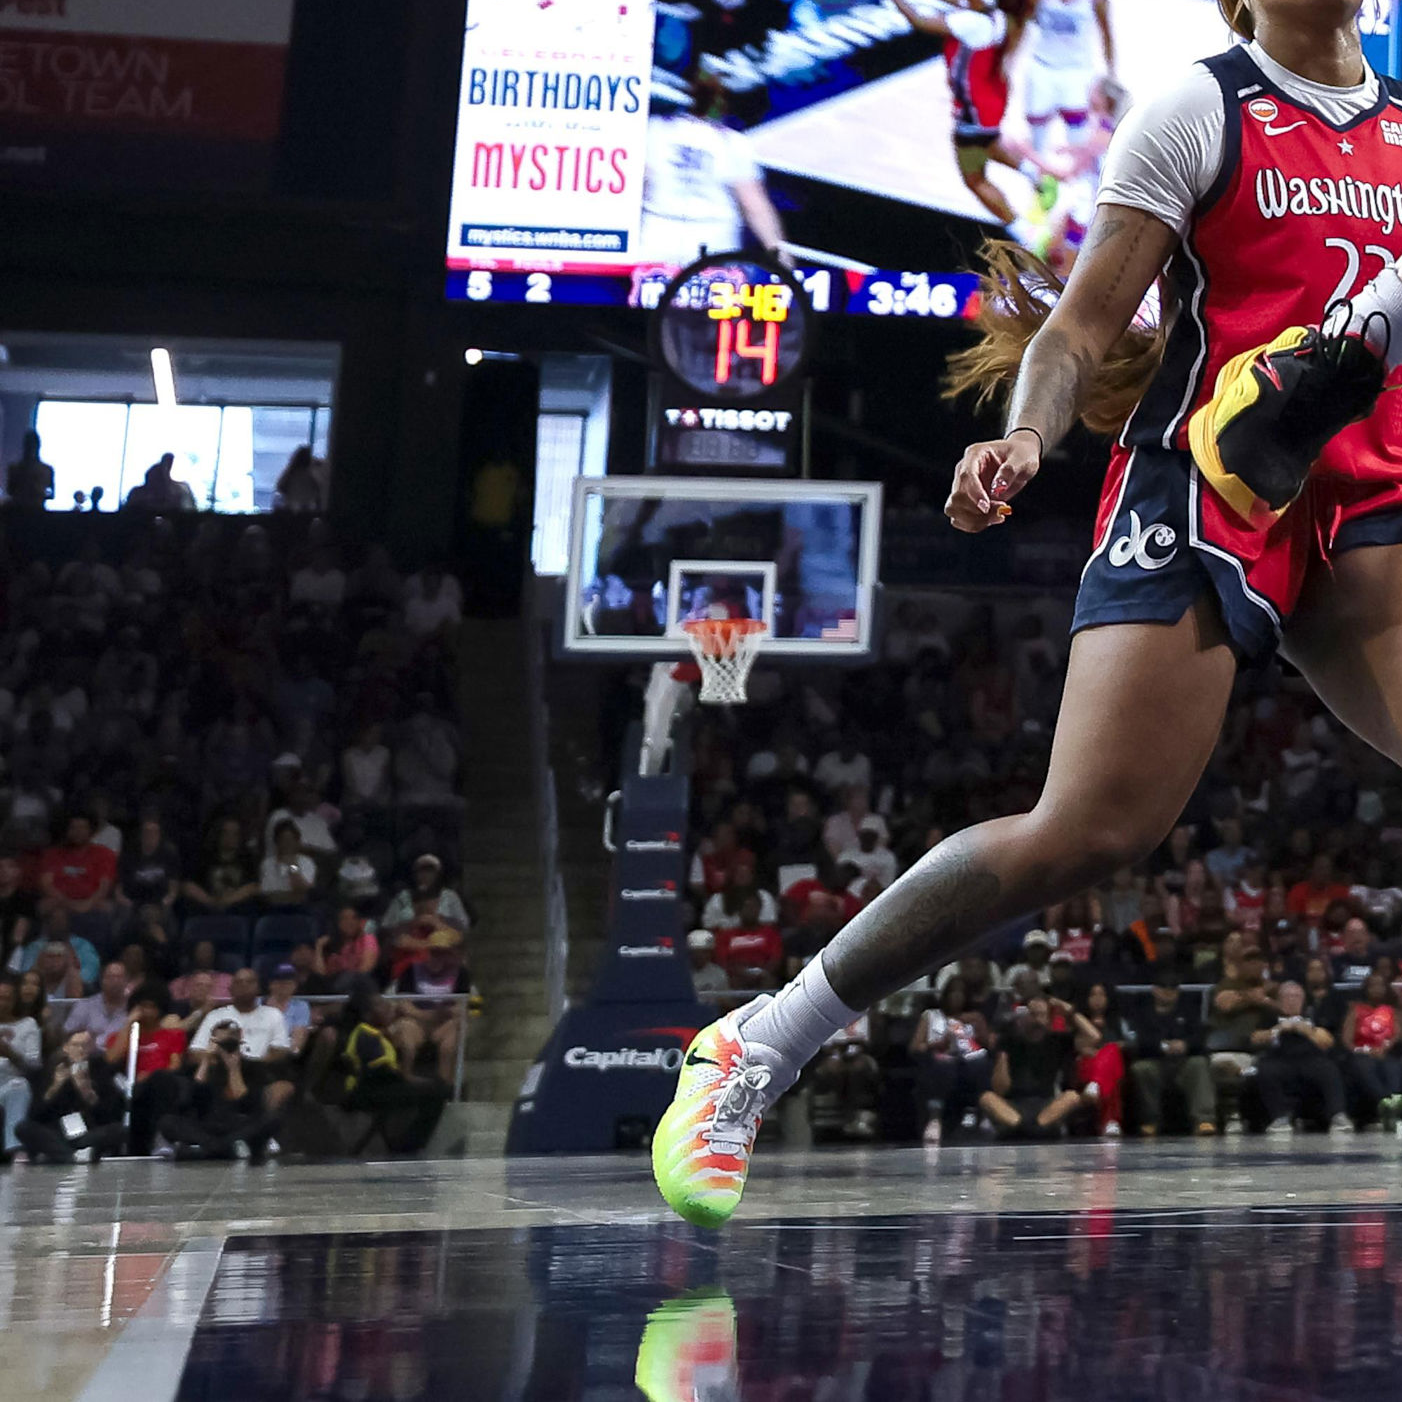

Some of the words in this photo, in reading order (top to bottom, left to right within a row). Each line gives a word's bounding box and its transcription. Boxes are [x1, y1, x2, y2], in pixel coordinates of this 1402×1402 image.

[468, 67, 642, 114] BIRTHDAYS
[470, 141, 629, 196] MYSTICS
[466, 270, 494, 301] 5
[524, 272, 552, 304] 2
[867, 281, 957, 317] 3:46
[714, 318, 781, 385] 14
[699, 408, 793, 432] TISSOT
